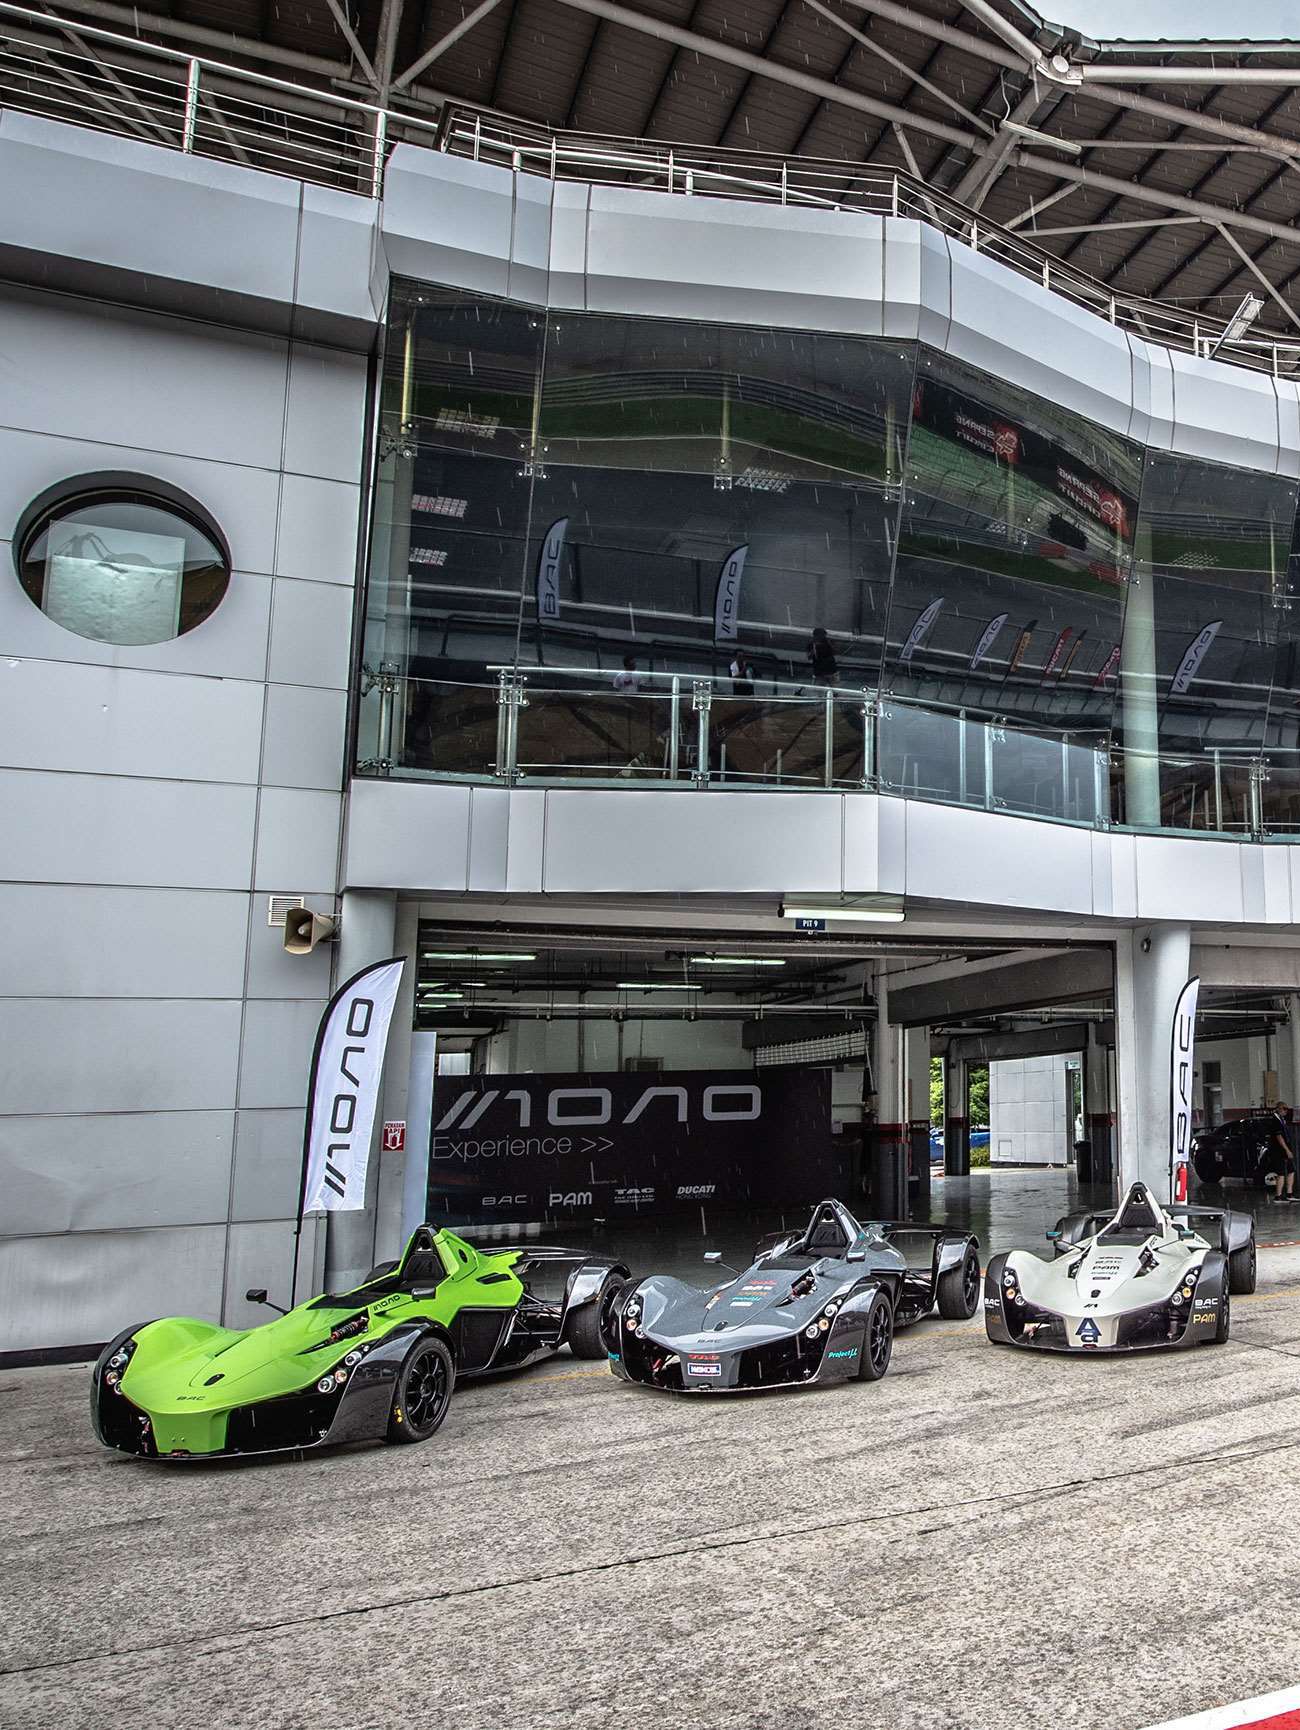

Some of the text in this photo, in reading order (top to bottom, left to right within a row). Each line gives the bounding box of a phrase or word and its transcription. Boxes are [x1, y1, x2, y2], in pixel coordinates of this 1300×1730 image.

[544, 539, 561, 615] BAC
[802, 919, 813, 927] PIT
[1177, 1014, 1191, 1154] BAC
[432, 1134, 573, 1163] Experience
[614, 1187, 655, 1195] TAC
[676, 1184, 716, 1195] DUCATI
[481, 1195, 528, 1206] BAC
[549, 1191, 593, 1207] PAM
[1194, 1297, 1219, 1306] BAC
[1192, 1313, 1217, 1324] PAM
